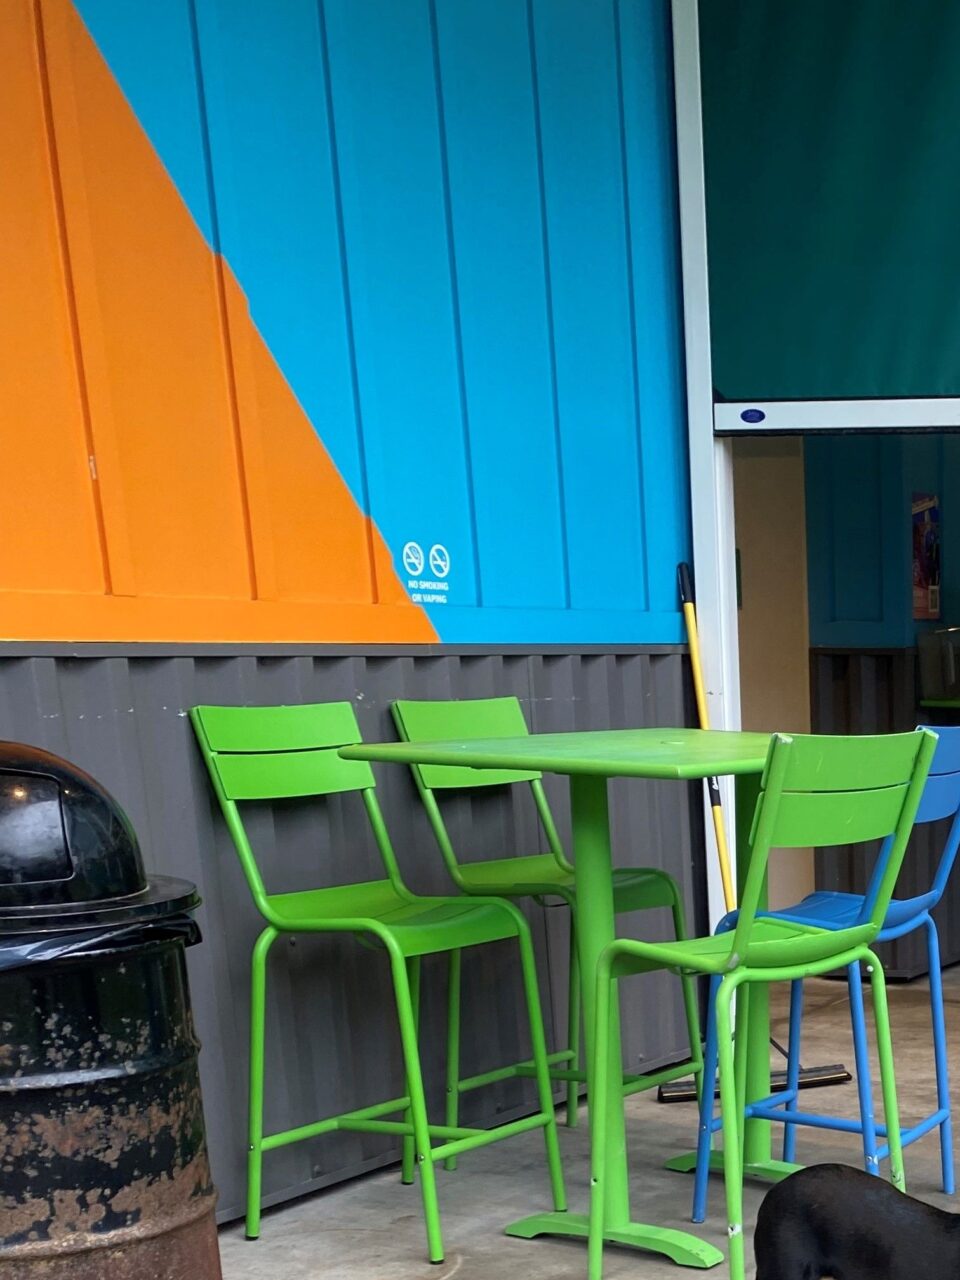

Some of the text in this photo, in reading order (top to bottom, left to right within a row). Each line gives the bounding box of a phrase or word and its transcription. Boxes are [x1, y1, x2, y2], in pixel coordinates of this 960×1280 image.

[408, 580, 449, 591] NO SMOKING
[412, 593, 447, 604] OR VAPING
